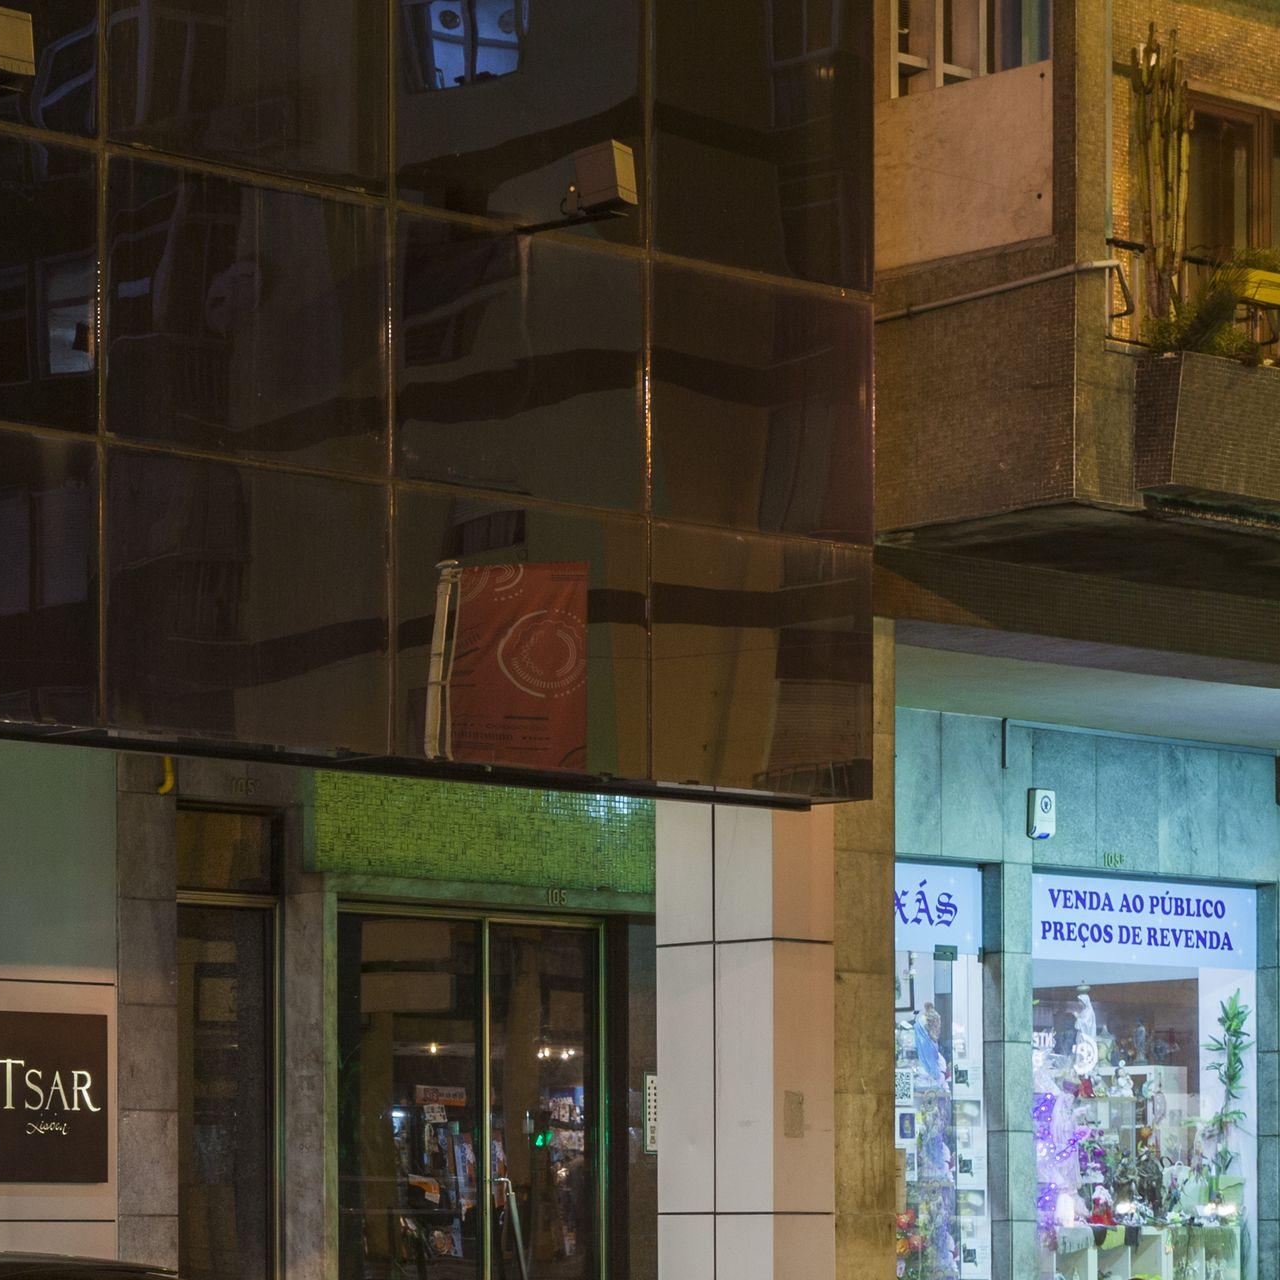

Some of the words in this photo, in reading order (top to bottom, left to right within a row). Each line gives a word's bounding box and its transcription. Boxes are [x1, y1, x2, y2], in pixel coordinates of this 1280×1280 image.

[548, 888, 567, 905] 105
[1048, 888, 1114, 912] VENDA
[1119, 893, 1144, 914] AO
[1149, 890, 1226, 919] PÚBLICO
[1041, 920, 1113, 948] PREÇOS
[1118, 925, 1143, 945] DE
[1146, 927, 1234, 951] REVENDA
